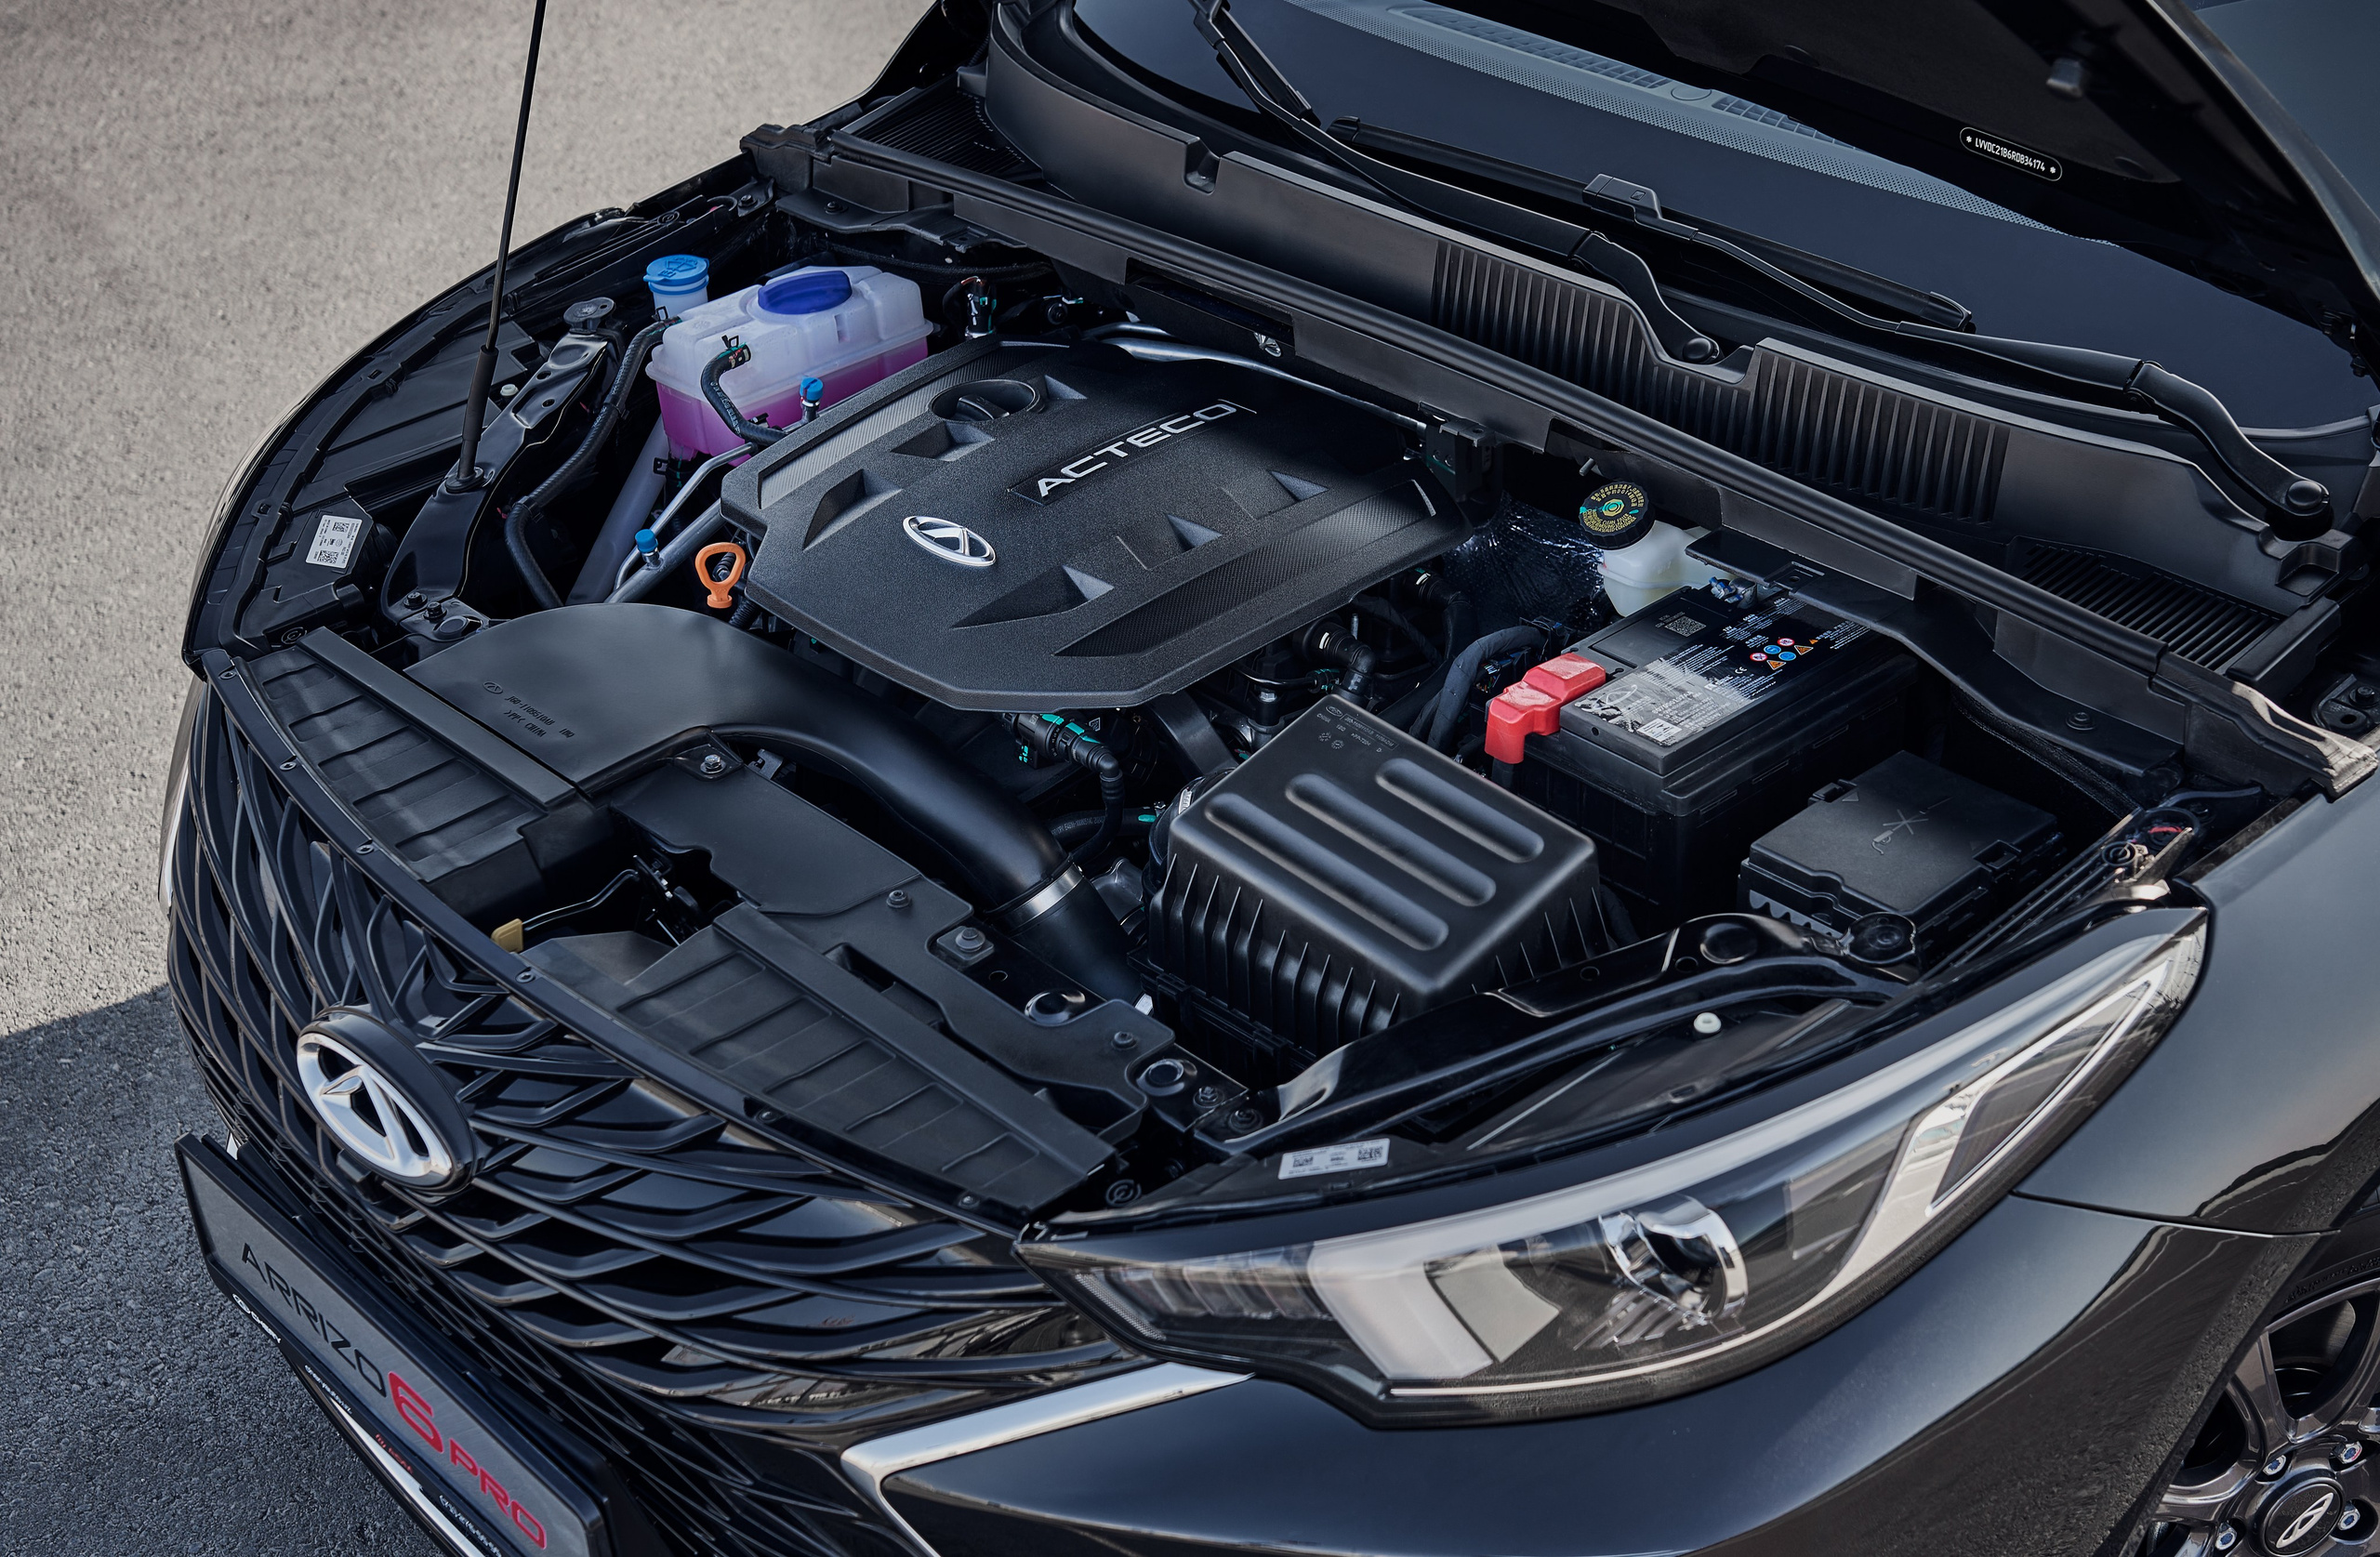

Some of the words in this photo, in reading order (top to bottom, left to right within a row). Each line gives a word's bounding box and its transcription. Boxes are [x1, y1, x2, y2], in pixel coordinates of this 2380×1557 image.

[1038, 403, 1236, 497] ACTECO
[242, 1242, 388, 1398] ARRIZO
[388, 1371, 443, 1454] 6
[449, 1438, 547, 1550] PRO
